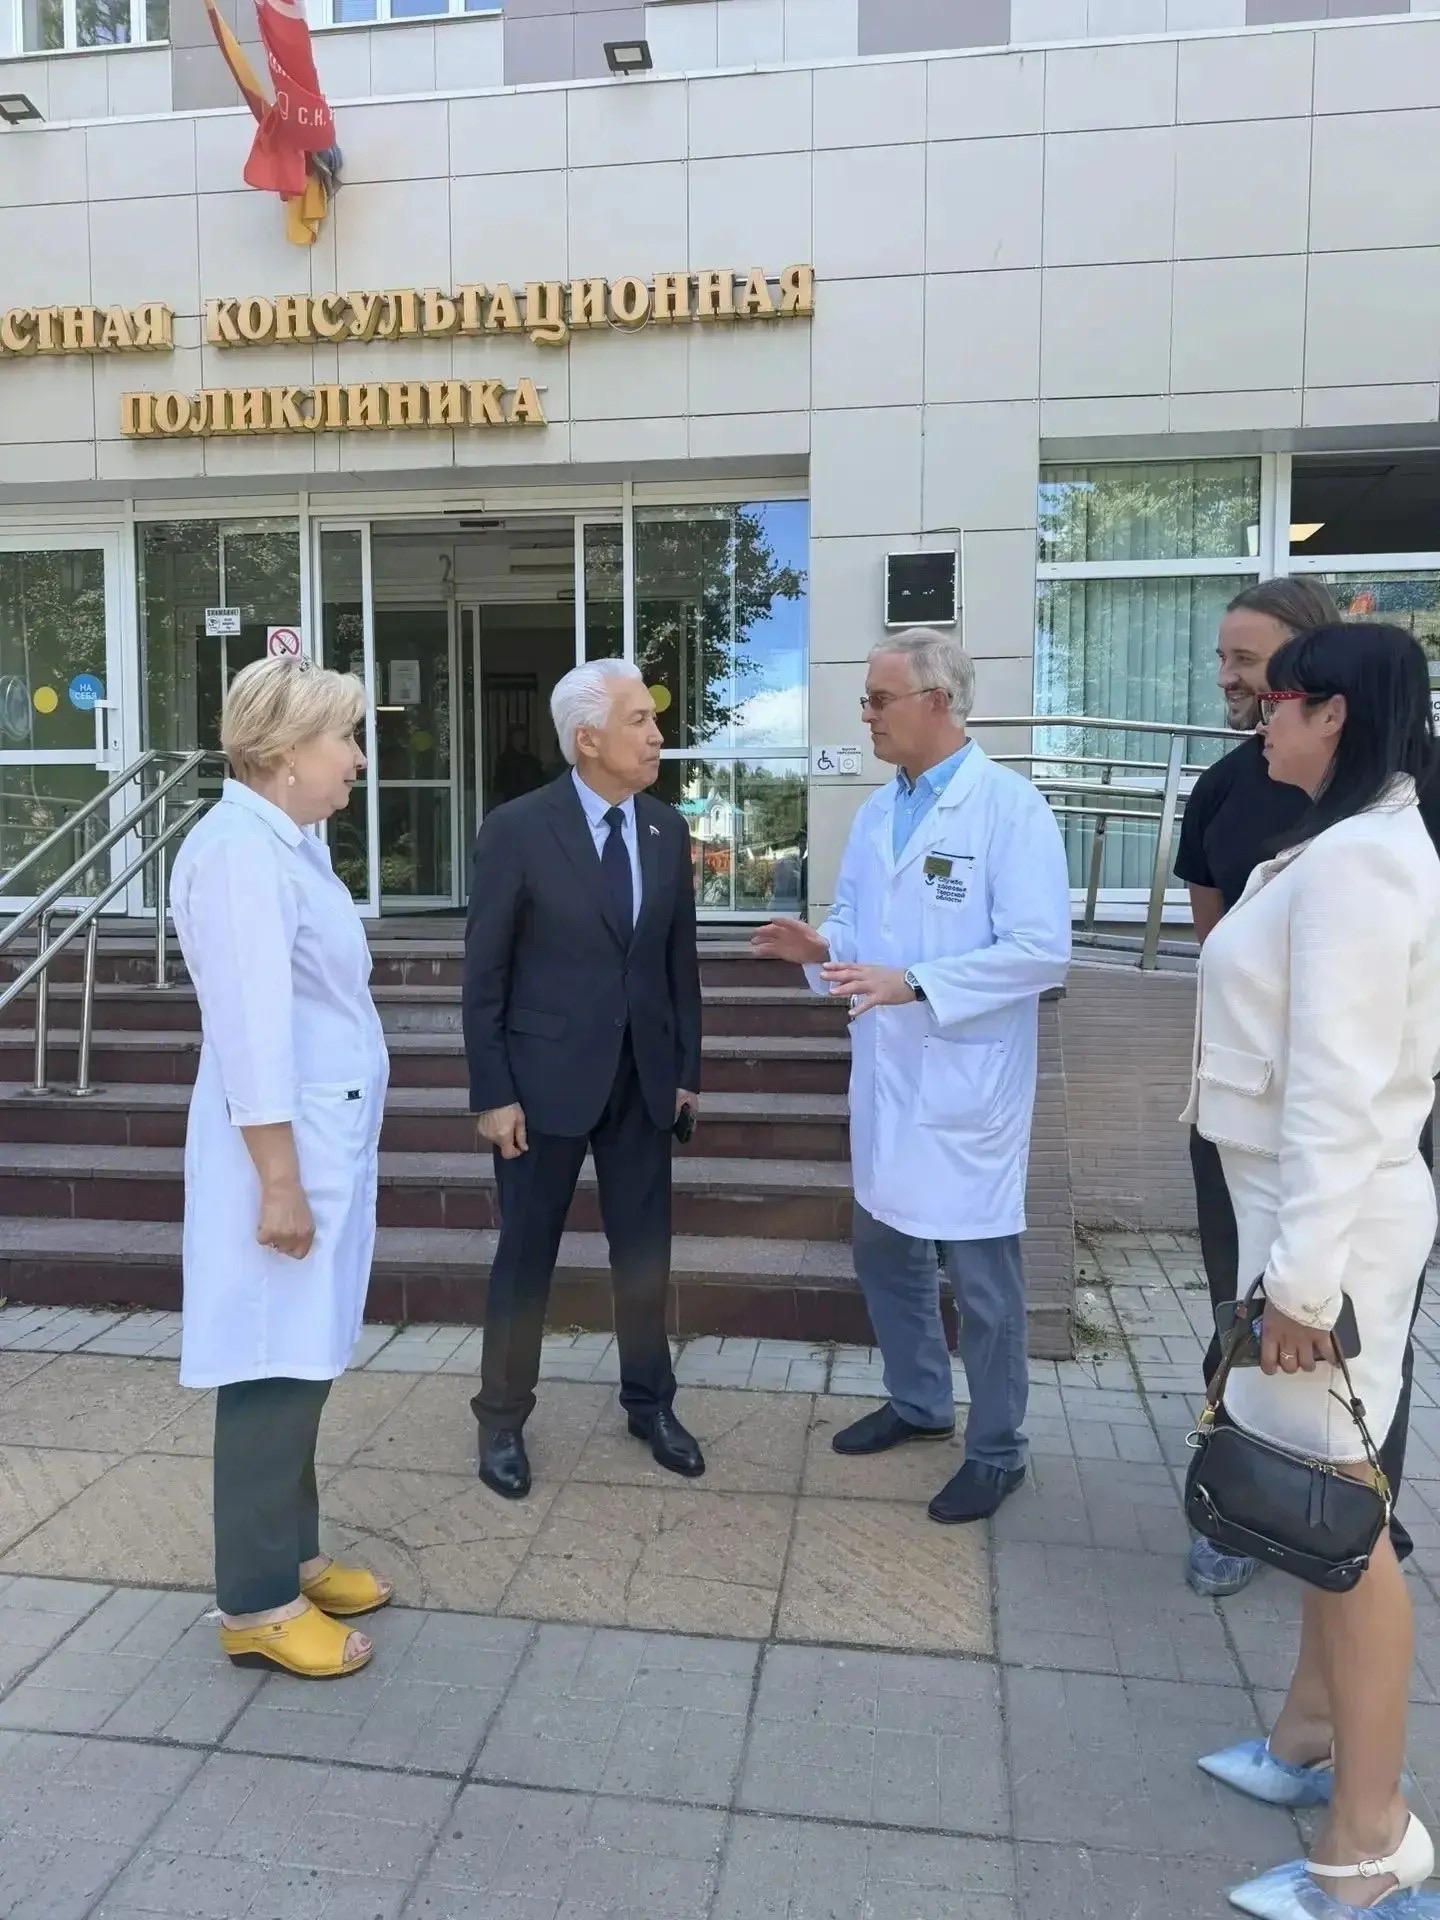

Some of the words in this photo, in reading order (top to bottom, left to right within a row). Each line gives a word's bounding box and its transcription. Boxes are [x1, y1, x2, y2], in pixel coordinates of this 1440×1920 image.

[0, 302, 172, 354] СТНАЯ
[204, 264, 814, 347] КОНСУЛЬТАЦИОННАЯ
[121, 377, 546, 436] ПОЛИКЛИНИКА
